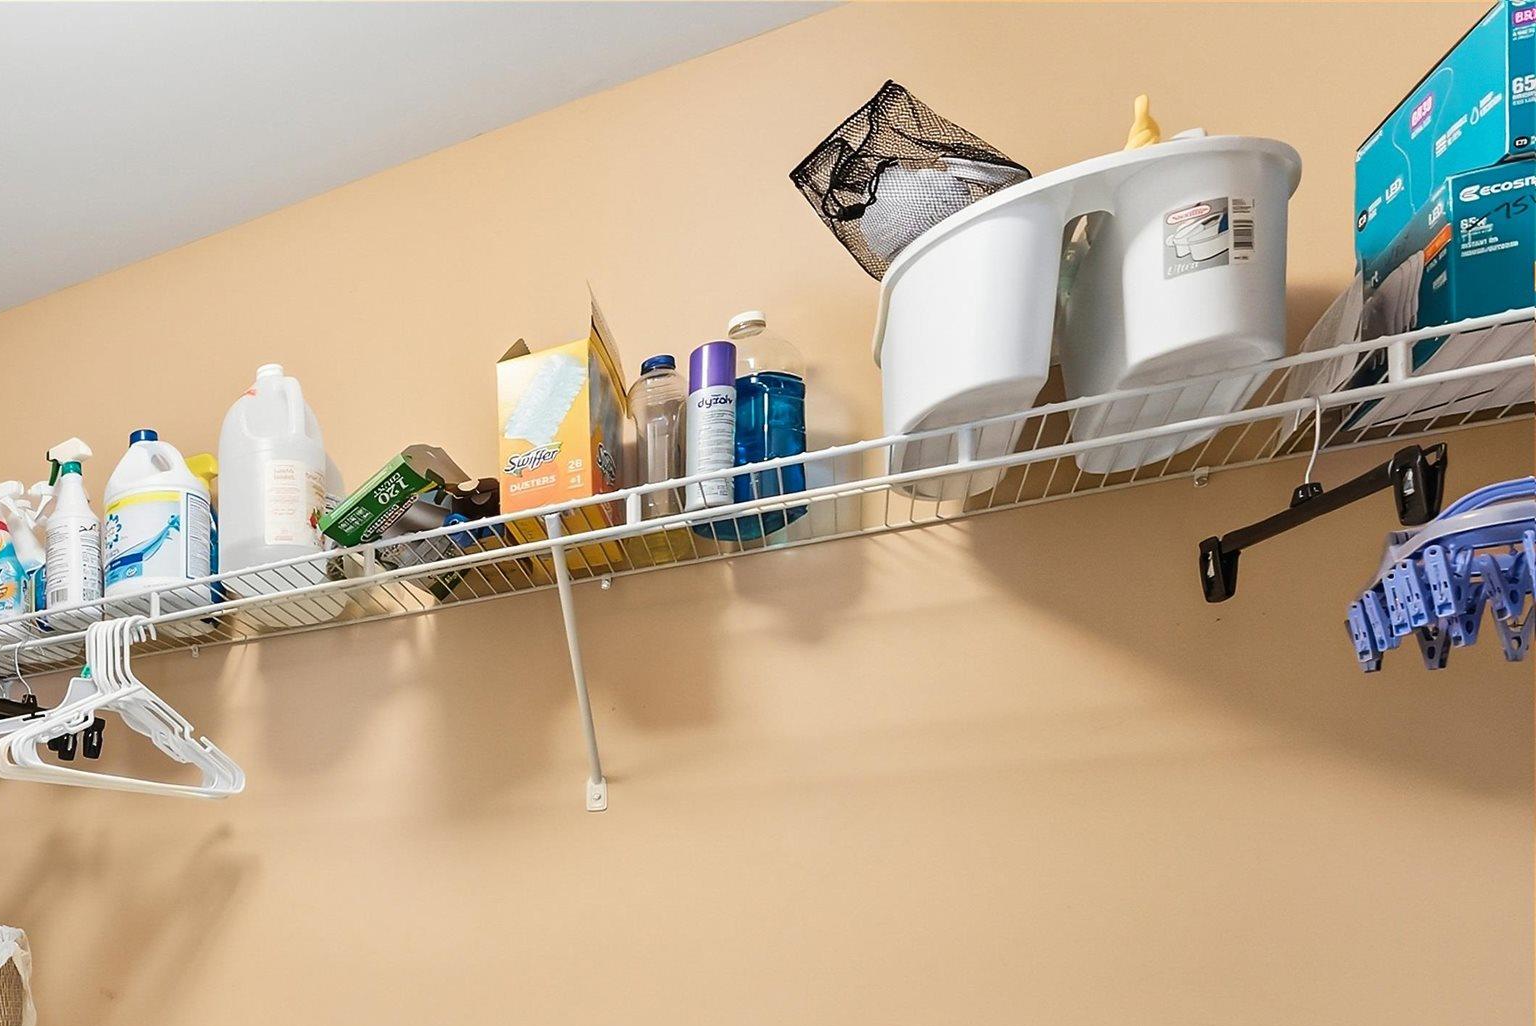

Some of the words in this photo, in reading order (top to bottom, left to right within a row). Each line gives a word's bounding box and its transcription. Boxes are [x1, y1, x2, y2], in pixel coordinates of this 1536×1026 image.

[503, 447, 561, 473] Swiffer
[377, 476, 409, 505] 120
[509, 474, 556, 492] DUSTERS
